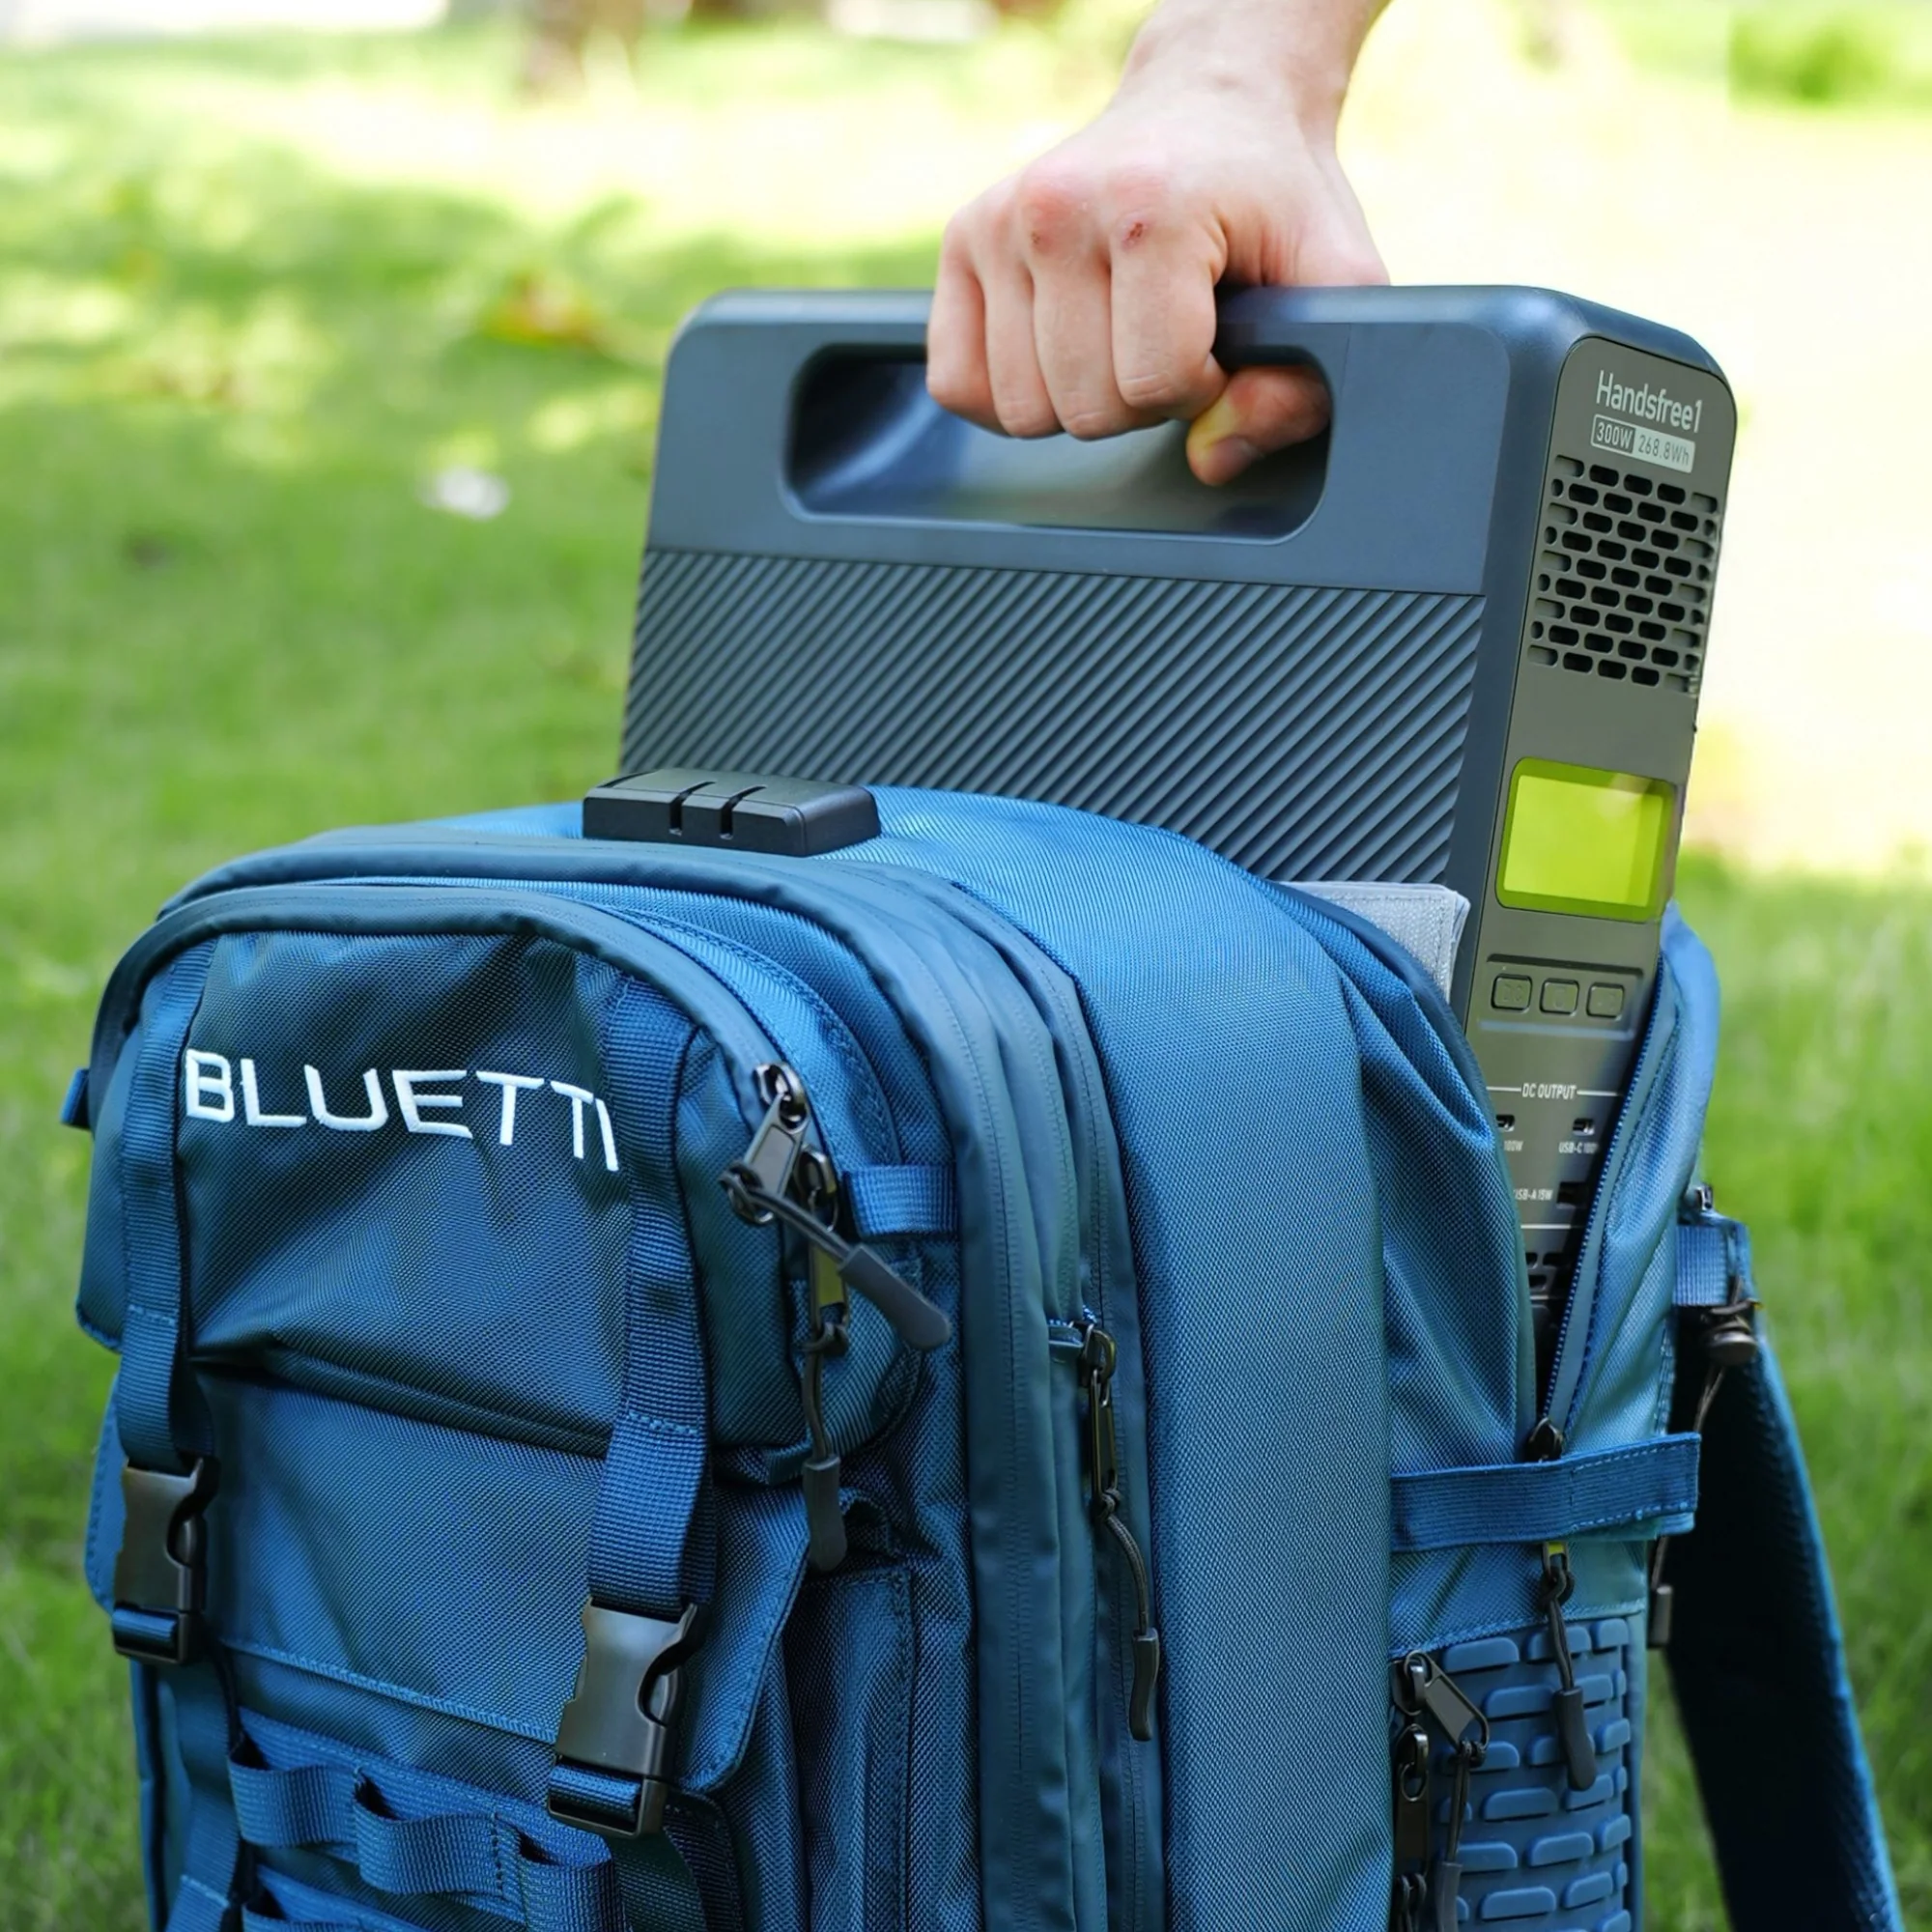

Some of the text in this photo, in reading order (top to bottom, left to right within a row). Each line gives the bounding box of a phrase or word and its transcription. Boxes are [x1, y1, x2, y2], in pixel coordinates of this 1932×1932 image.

[1596, 370, 1702, 434] Handsfree1
[1596, 421, 1690, 466] 300W 268.8Wh
[185, 1047, 618, 1172] BLUETTI
[1522, 1083, 1577, 1100] DC OUTPUT
[1558, 1142, 1582, 1153] USB-C
